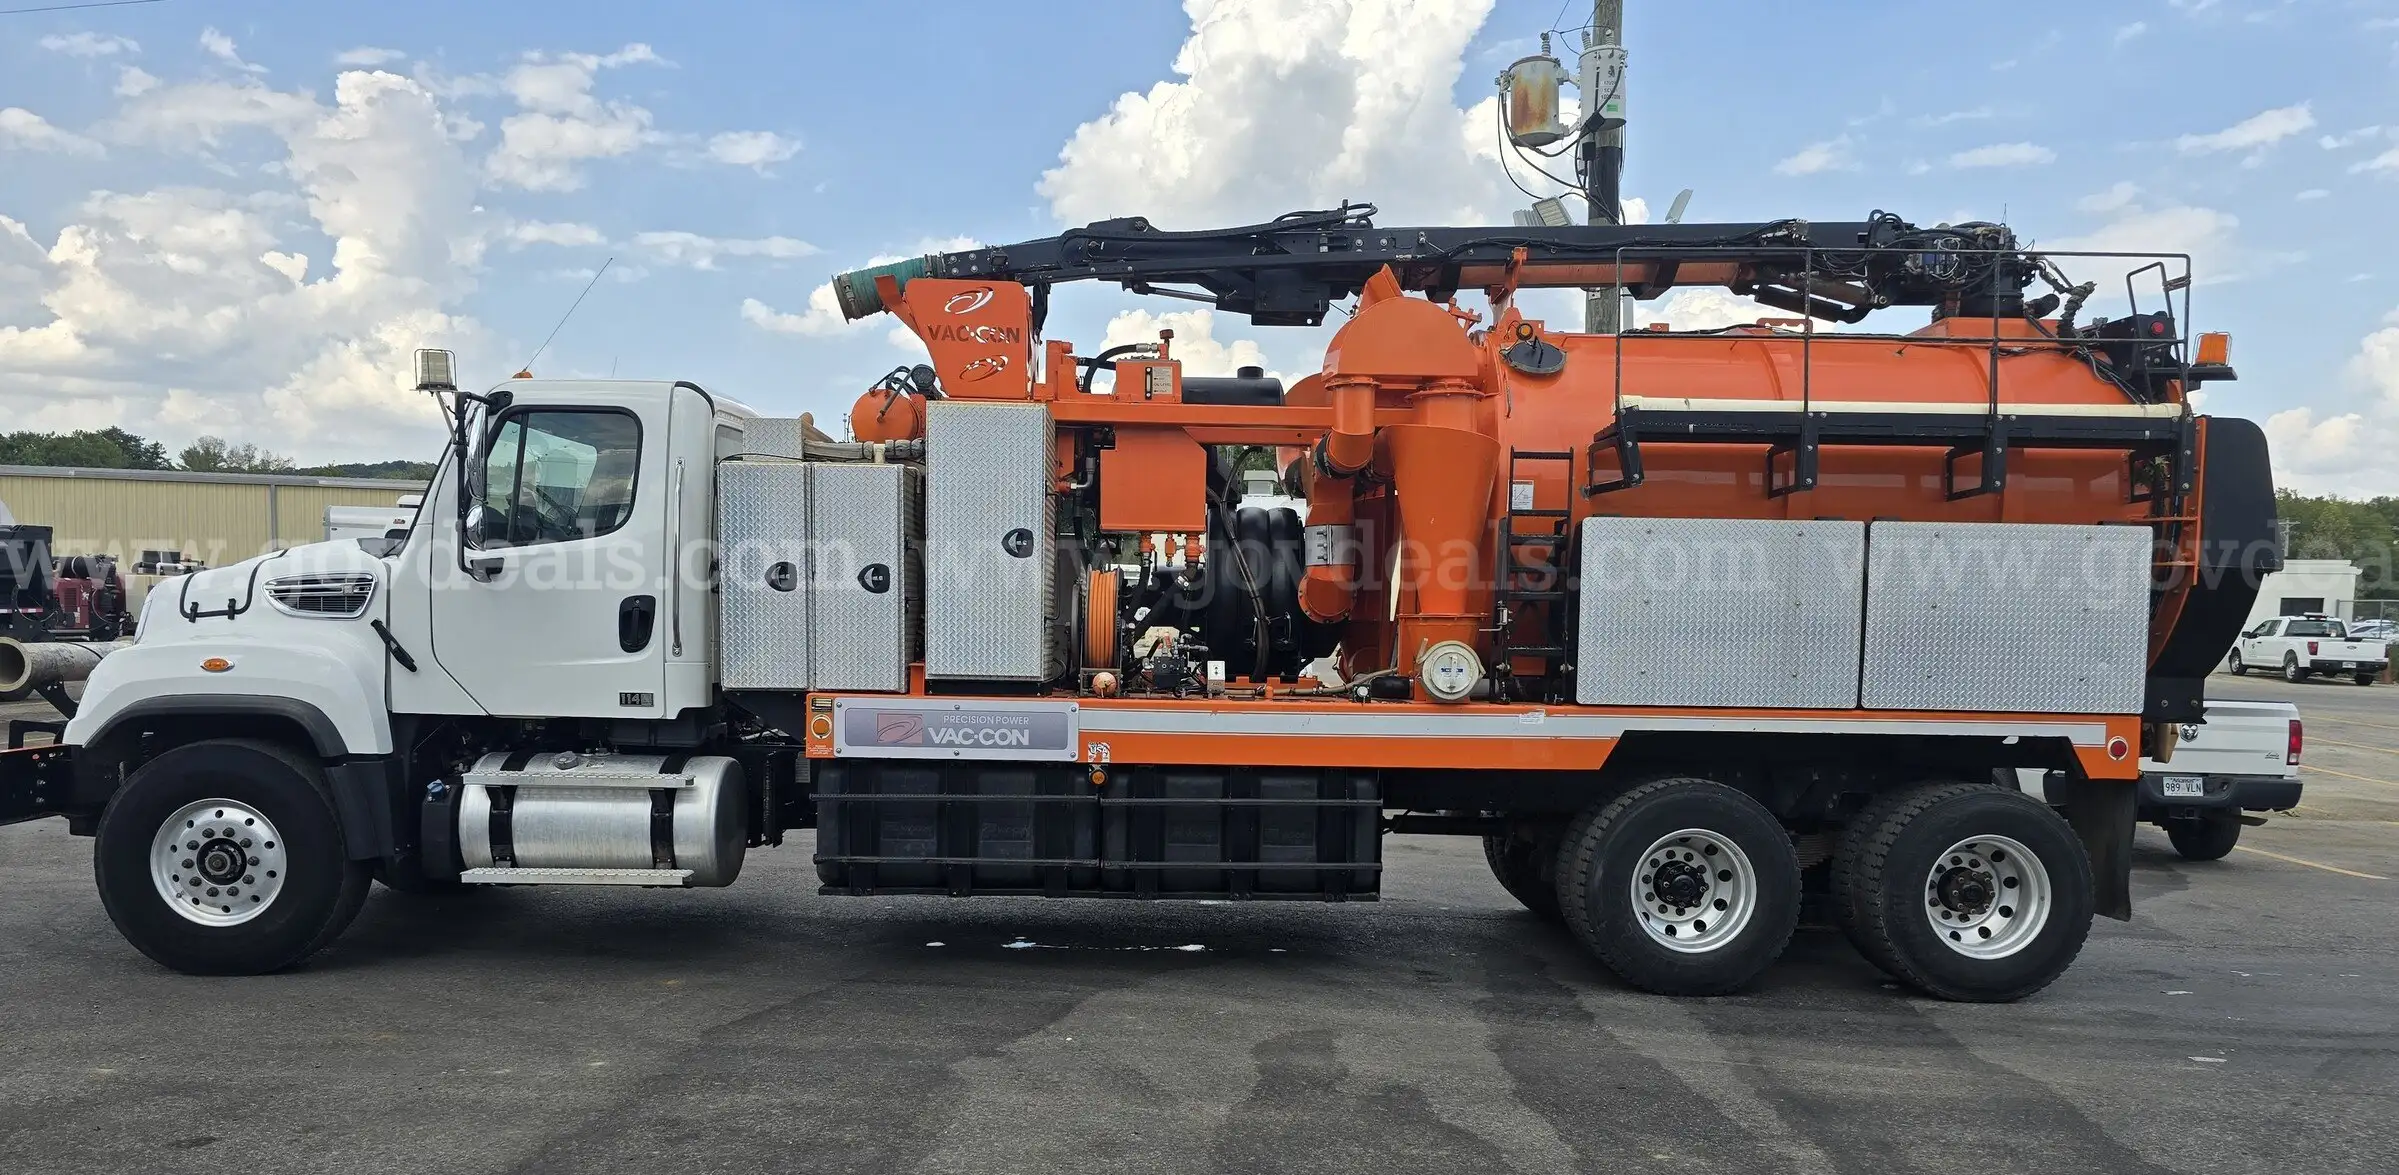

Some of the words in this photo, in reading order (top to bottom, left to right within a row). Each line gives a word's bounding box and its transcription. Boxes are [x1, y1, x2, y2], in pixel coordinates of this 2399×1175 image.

[943, 715, 995, 725] PRECISION
[996, 716, 1030, 726] POWER
[2165, 782, 2181, 792] 989
